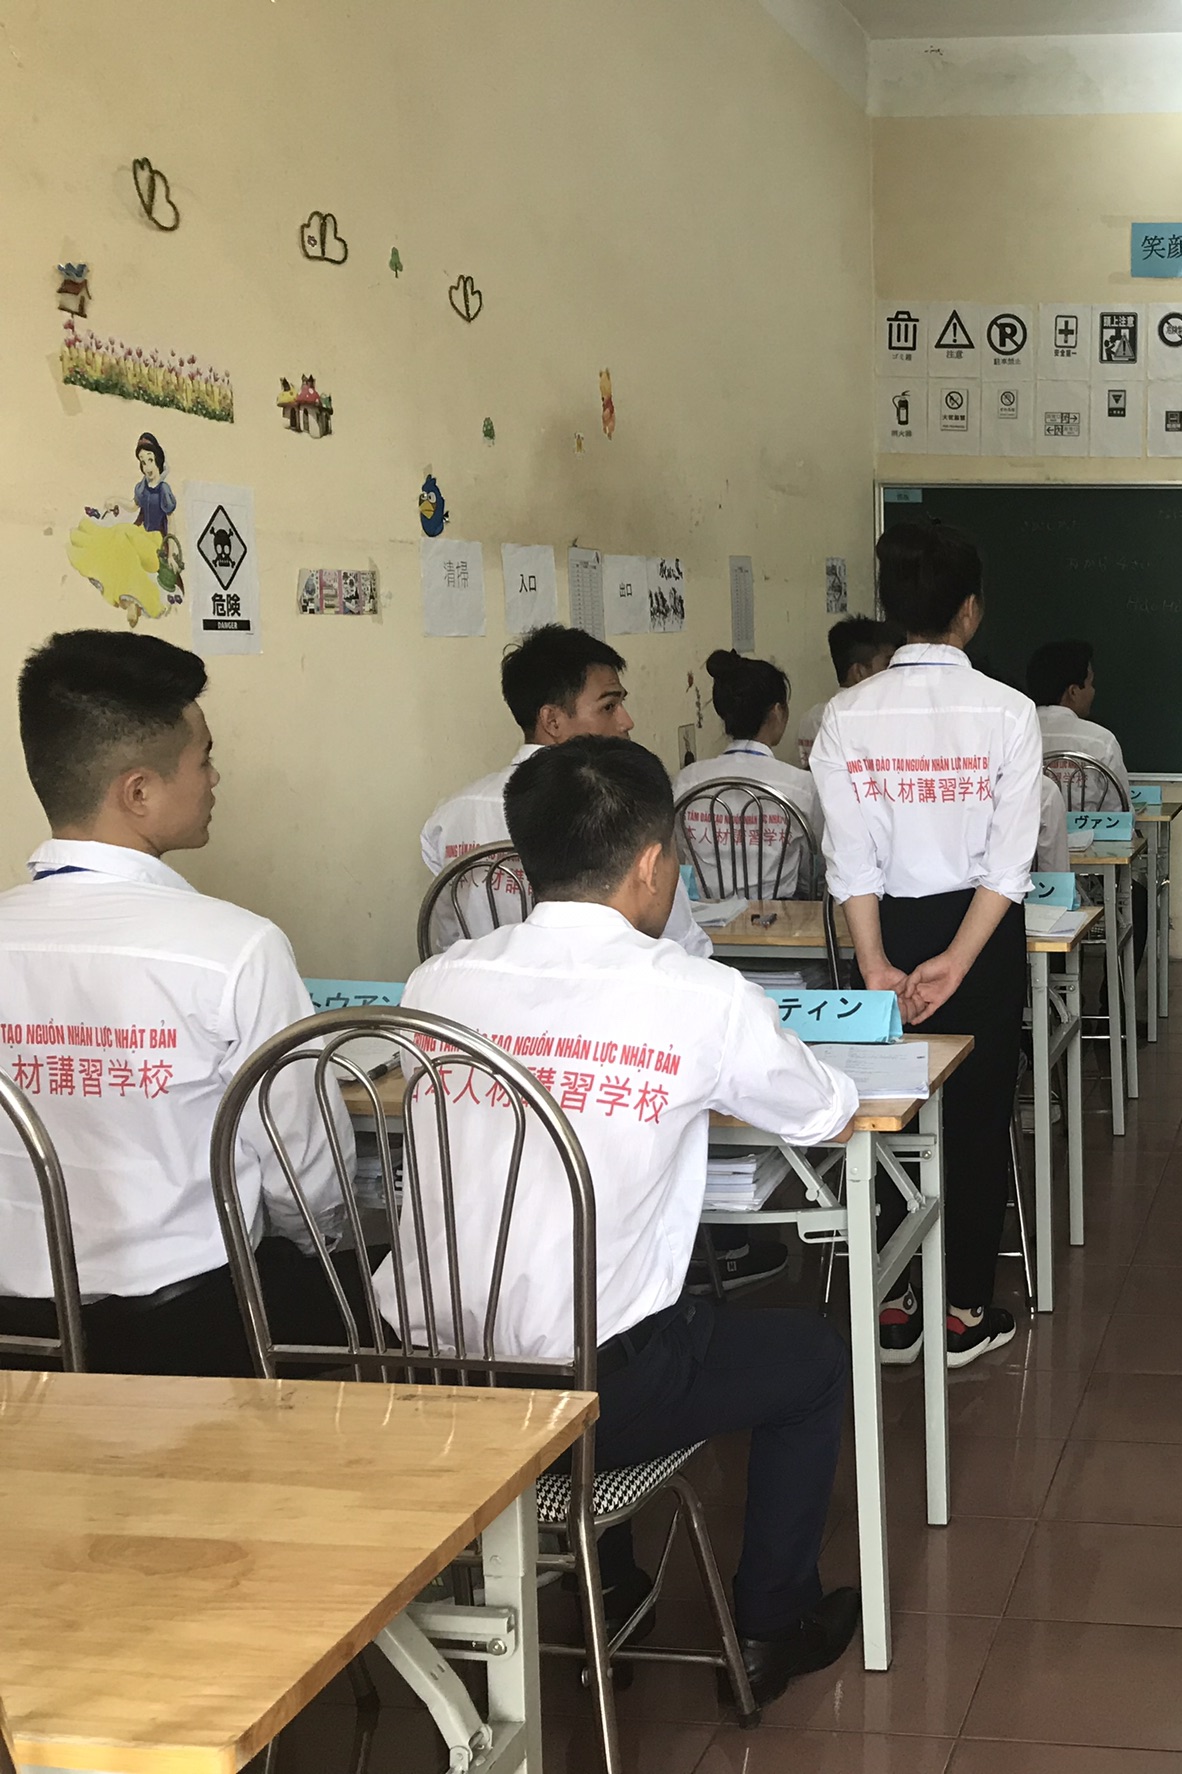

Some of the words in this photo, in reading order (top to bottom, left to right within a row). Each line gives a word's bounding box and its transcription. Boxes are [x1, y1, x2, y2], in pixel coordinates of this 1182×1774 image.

[1103, 316, 1135, 328] 頭上注意
[946, 350, 964, 359] 注意
[443, 560, 469, 588] 清掃
[519, 573, 537, 593] 入口
[619, 582, 632, 598] 出口
[211, 592, 241, 617] 危険
[217, 621, 238, 630] DANGER
[875, 756, 891, 772] ĐÀO
[892, 758, 905, 774] TẠO
[962, 754, 982, 773] NHẬT
[1074, 815, 1120, 829] ヴァン
[779, 997, 863, 1021] ティン
[0, 1023, 22, 1049] TẠO
[67, 1021, 93, 1047] NHÂN
[95, 1025, 113, 1052] LỰC
[114, 1024, 146, 1054] NHẬT
[149, 1020, 177, 1049] BẢN
[554, 1034, 592, 1061] NHÂN
[592, 1040, 618, 1068] LỰC
[619, 1043, 655, 1073] NHẬT
[654, 1044, 681, 1076] BẢN
[12, 1054, 174, 1100] 材講習学校
